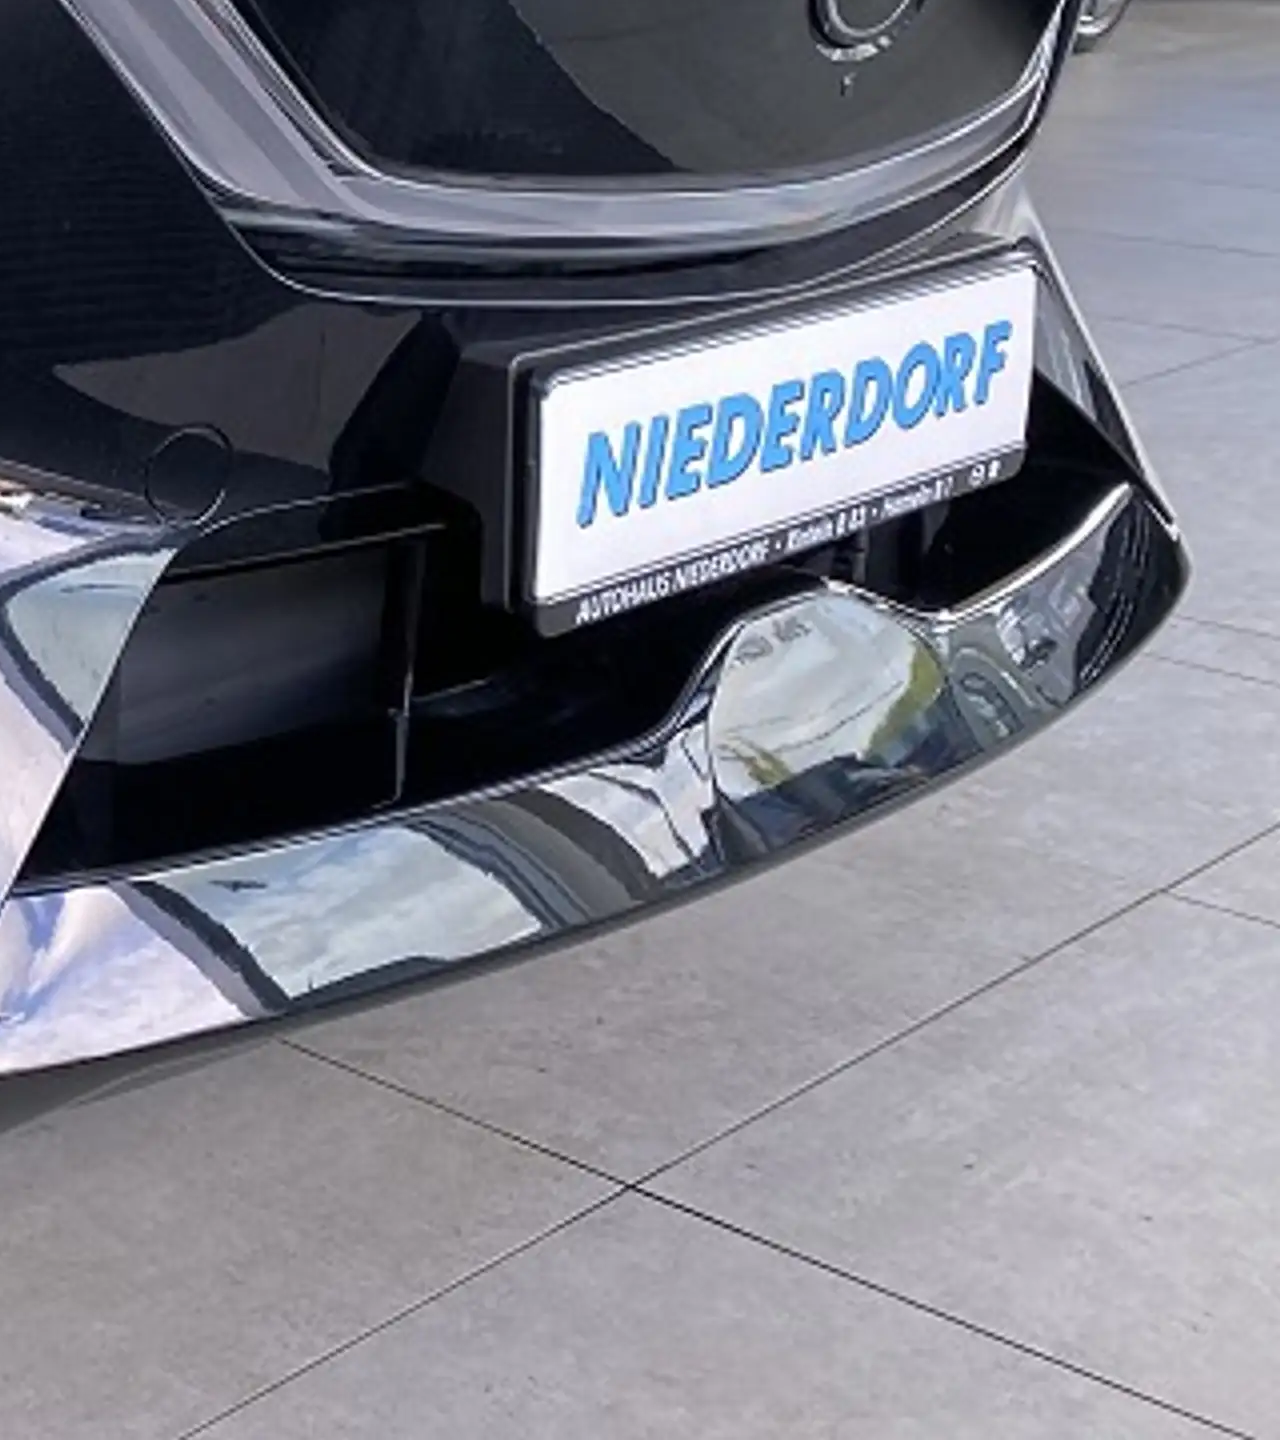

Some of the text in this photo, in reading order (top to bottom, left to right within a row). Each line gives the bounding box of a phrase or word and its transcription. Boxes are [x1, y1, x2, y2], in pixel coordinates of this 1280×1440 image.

[575, 319, 1013, 529] NIEDERDORF
[574, 571, 672, 625] AUTOHAUS
[671, 536, 770, 593] NIEDERDORF
